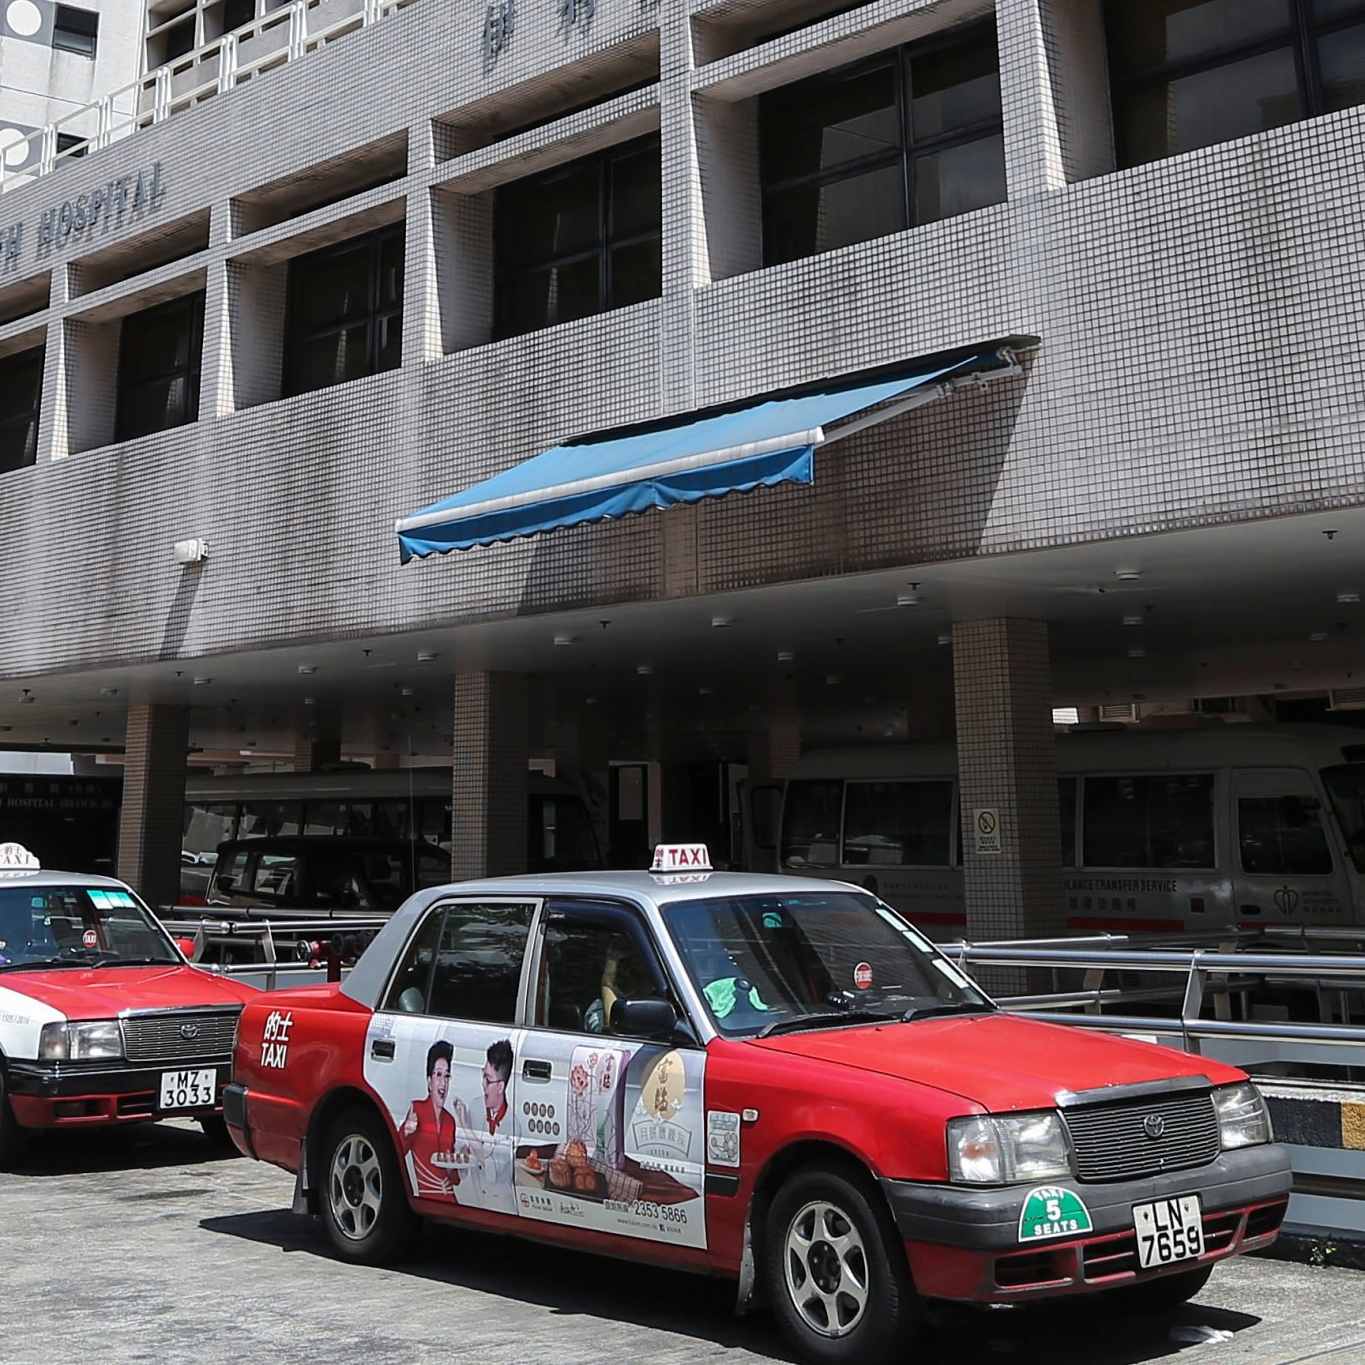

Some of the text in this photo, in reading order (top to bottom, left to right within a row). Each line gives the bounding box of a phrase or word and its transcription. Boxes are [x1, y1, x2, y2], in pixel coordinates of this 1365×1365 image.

[36, 162, 166, 249] HOSPITAL
[7, 797, 54, 808] HOSPITAL
[668, 848, 707, 866] TAXI
[1095, 878, 1138, 892] TRANSFER
[1141, 878, 1178, 892] SERVICE
[263, 1010, 294, 1042] 的士
[260, 1042, 287, 1069] TAXI
[176, 1070, 200, 1090] MZ
[654, 1057, 674, 1112] 富臨
[164, 1086, 212, 1107] 3033
[1033, 1188, 1065, 1202] TAXI
[634, 1201, 660, 1219] 2353
[661, 1205, 688, 1224] 5866
[1046, 1198, 1062, 1221] 5
[1152, 1197, 1184, 1233] LN
[1033, 1219, 1078, 1236] SEATS
[1141, 1225, 1202, 1266] 7659
